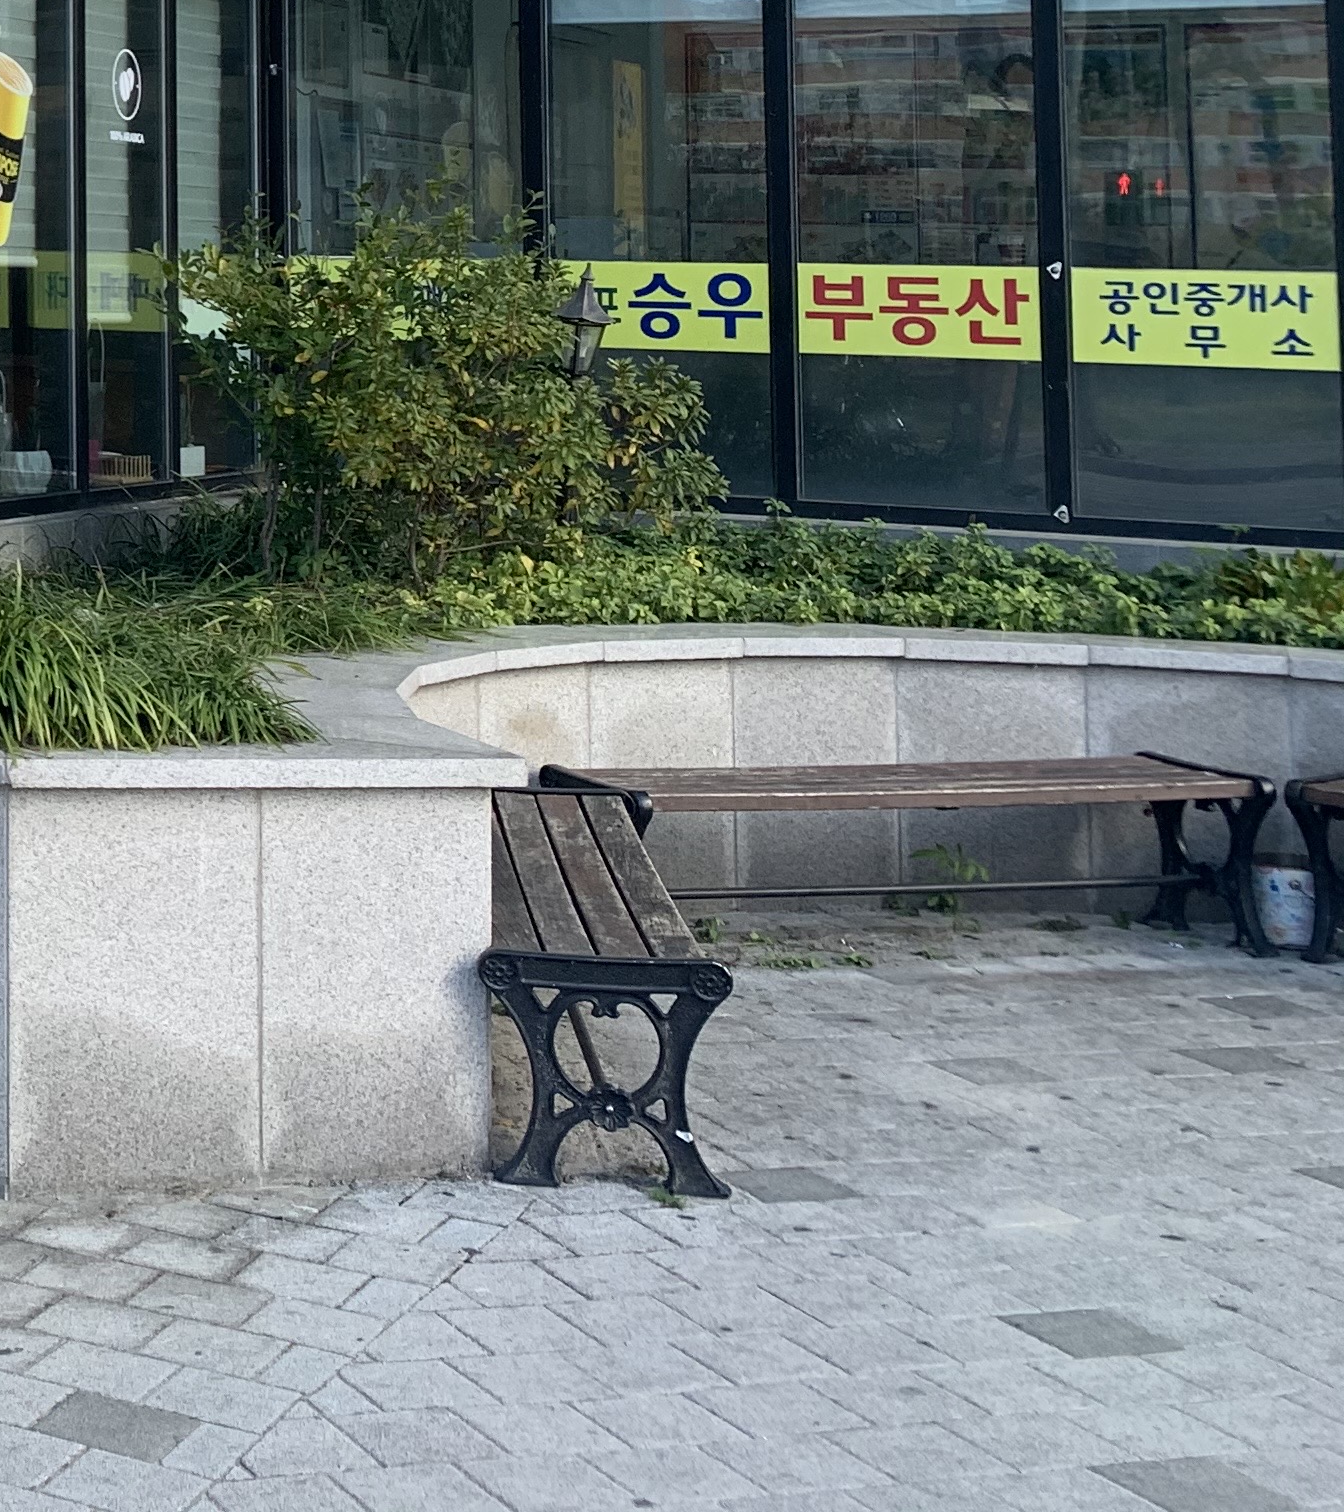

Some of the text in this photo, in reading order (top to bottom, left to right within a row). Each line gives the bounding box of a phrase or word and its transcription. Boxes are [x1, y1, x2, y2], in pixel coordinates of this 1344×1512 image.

[628, 271, 764, 340] 승우
[805, 273, 1032, 346] 부동산
[1099, 280, 1315, 318] 공인중개사
